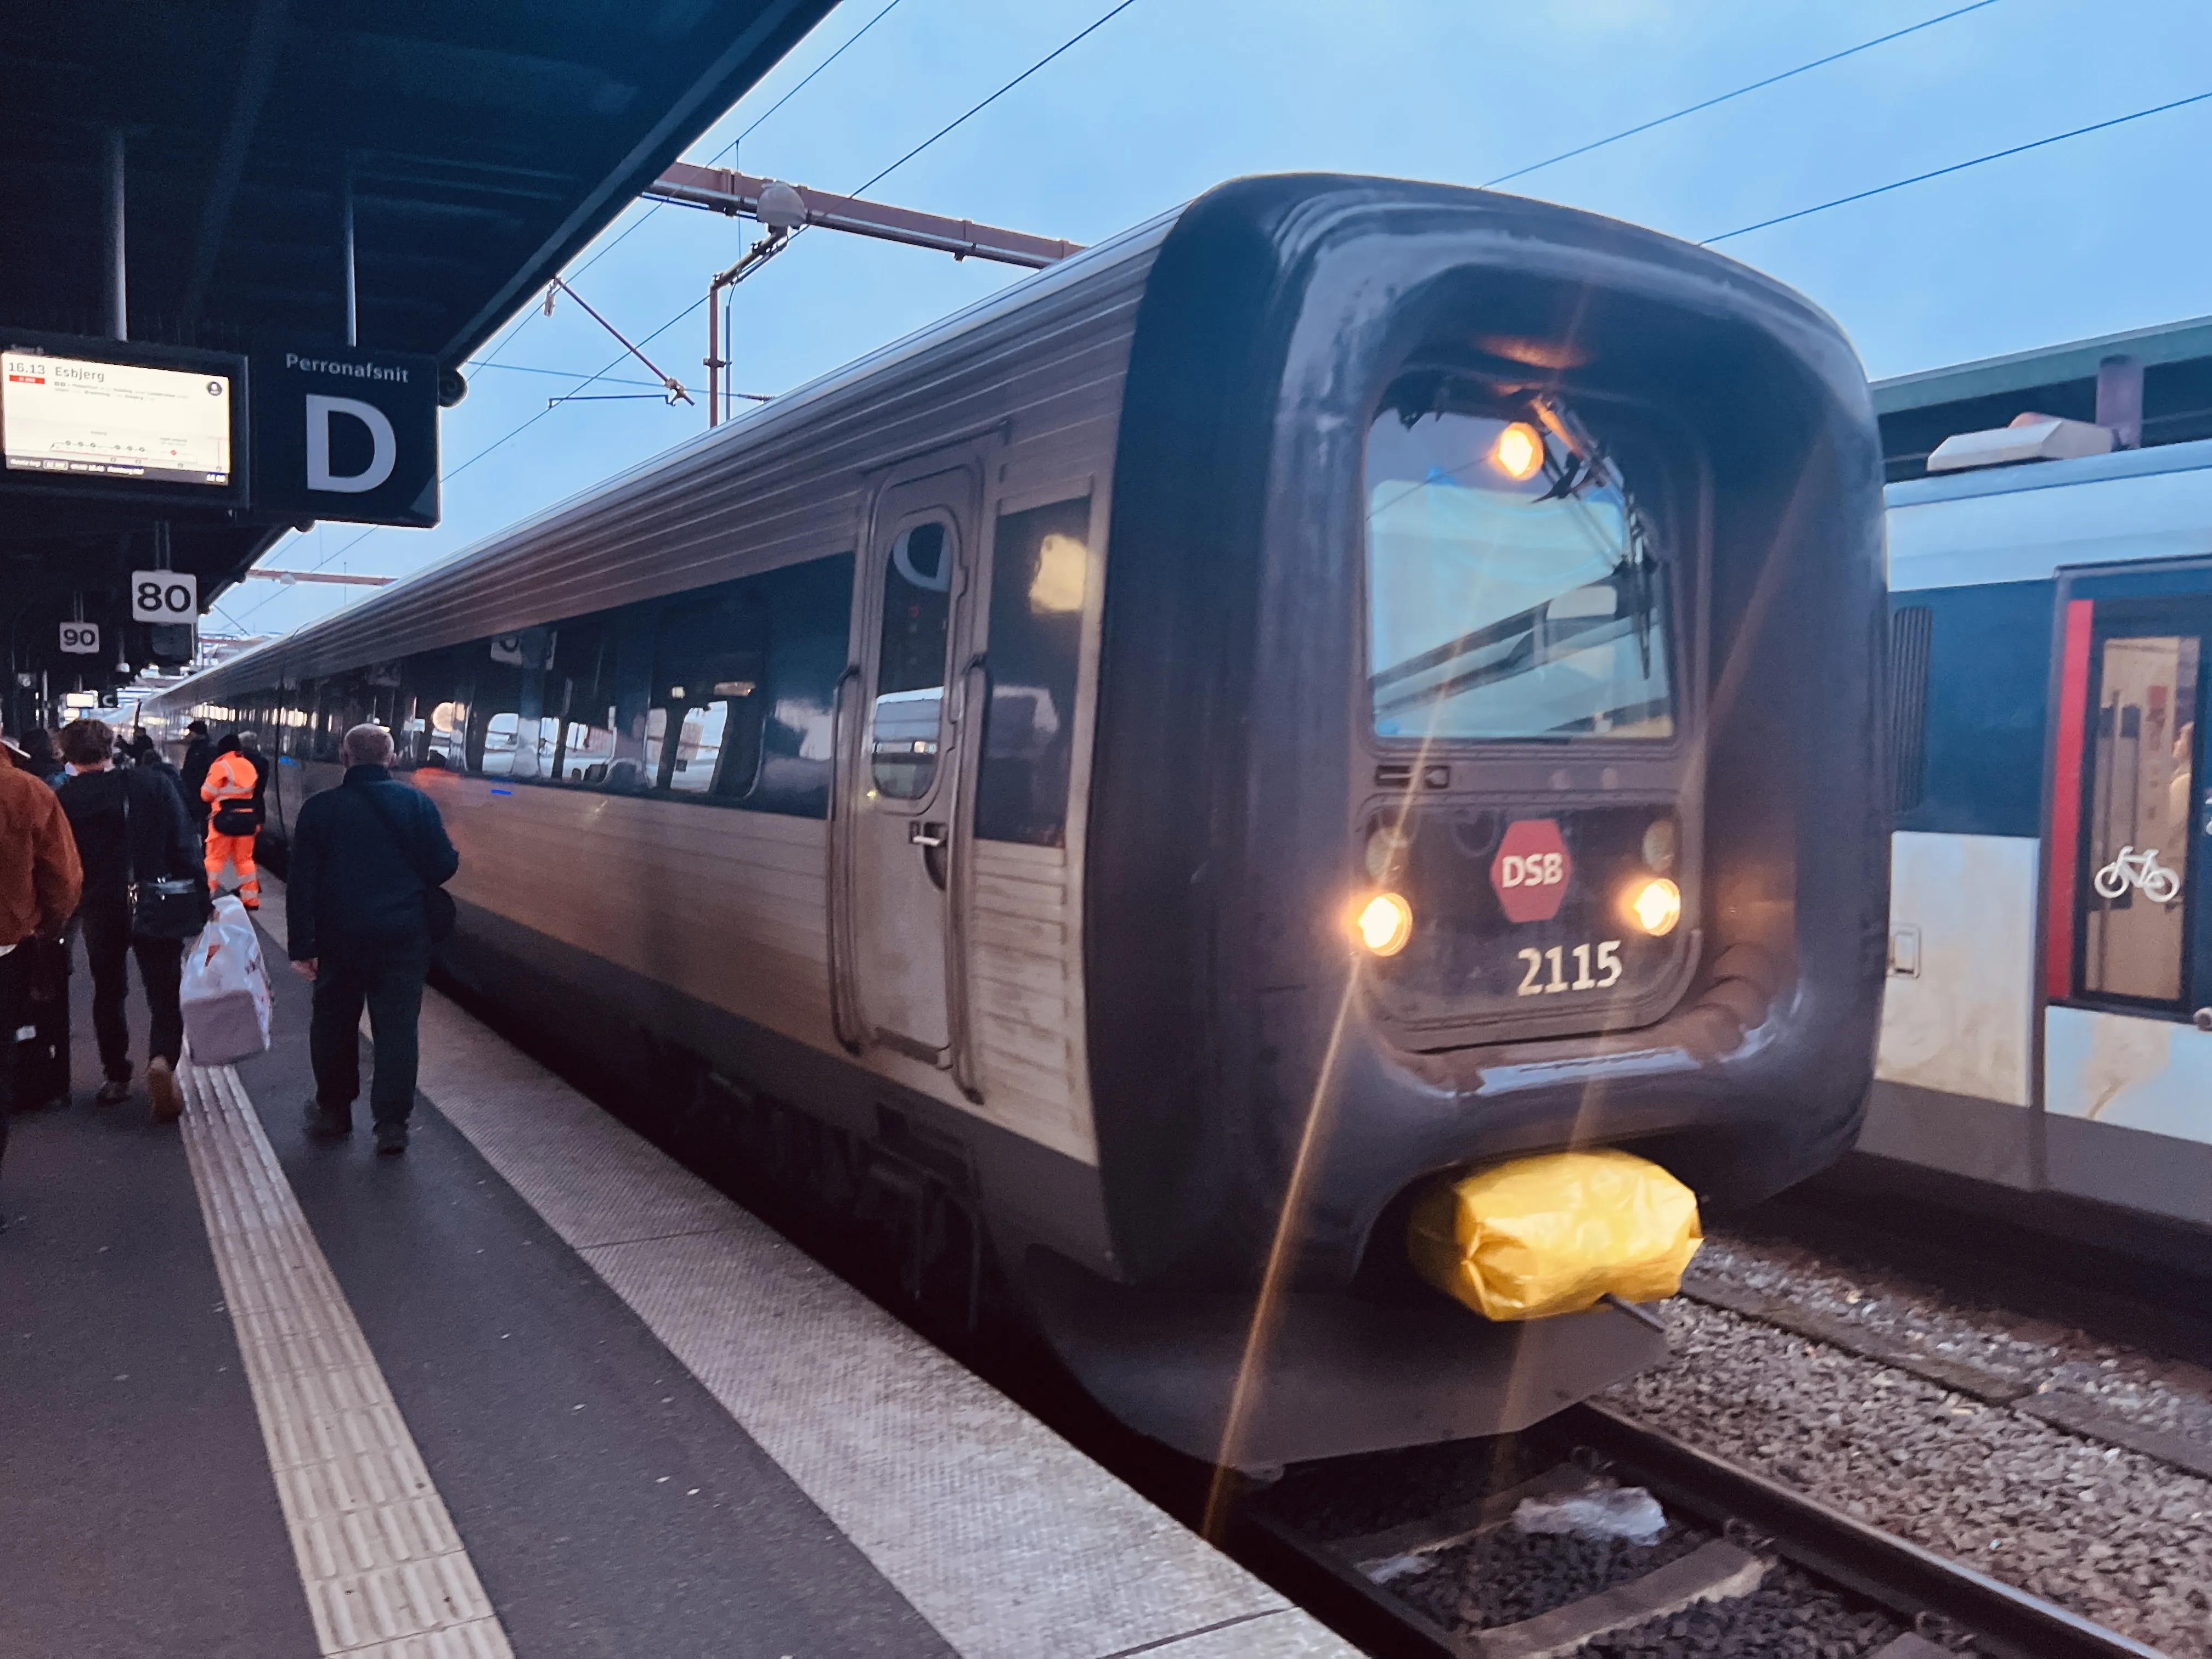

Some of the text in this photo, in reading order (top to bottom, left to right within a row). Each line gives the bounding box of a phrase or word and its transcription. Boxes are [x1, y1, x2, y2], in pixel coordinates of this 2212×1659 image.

[9, 362, 105, 382] 16.13 Esbjerg
[285, 352, 409, 383] Perronafsnit
[306, 392, 397, 493] D
[137, 582, 191, 612] 80
[63, 629, 95, 646] 90
[102, 694, 114, 707] C
[1502, 851, 1564, 888] DSB
[1516, 939, 1623, 997] 2115
